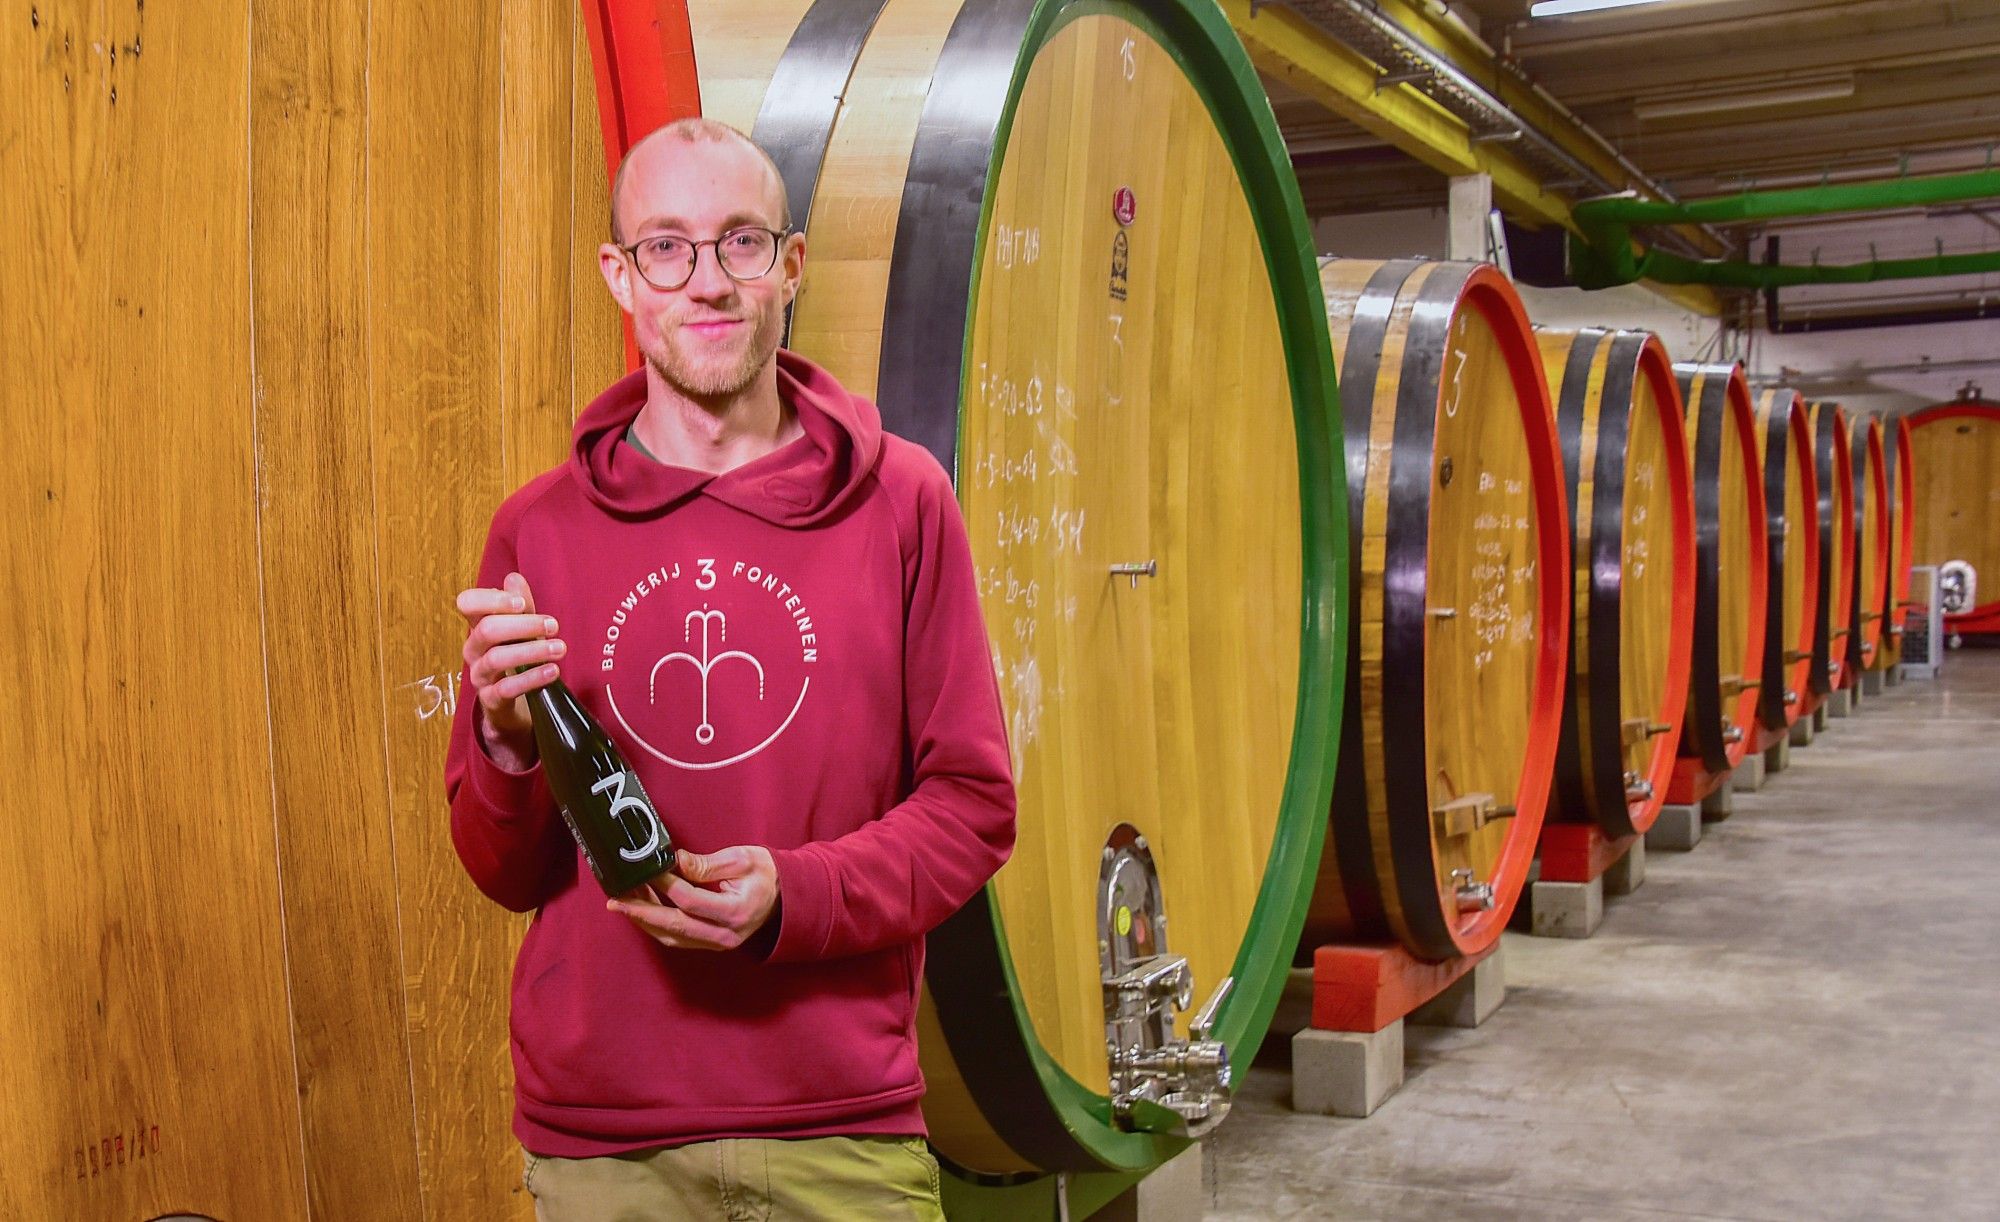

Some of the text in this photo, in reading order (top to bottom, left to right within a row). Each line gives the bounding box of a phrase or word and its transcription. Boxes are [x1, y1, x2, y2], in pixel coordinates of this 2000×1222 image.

[1445, 348, 1467, 418] 3
[601, 558, 818, 672] BROUWERIJ 3 FONTEINEN
[590, 771, 660, 863] 3
